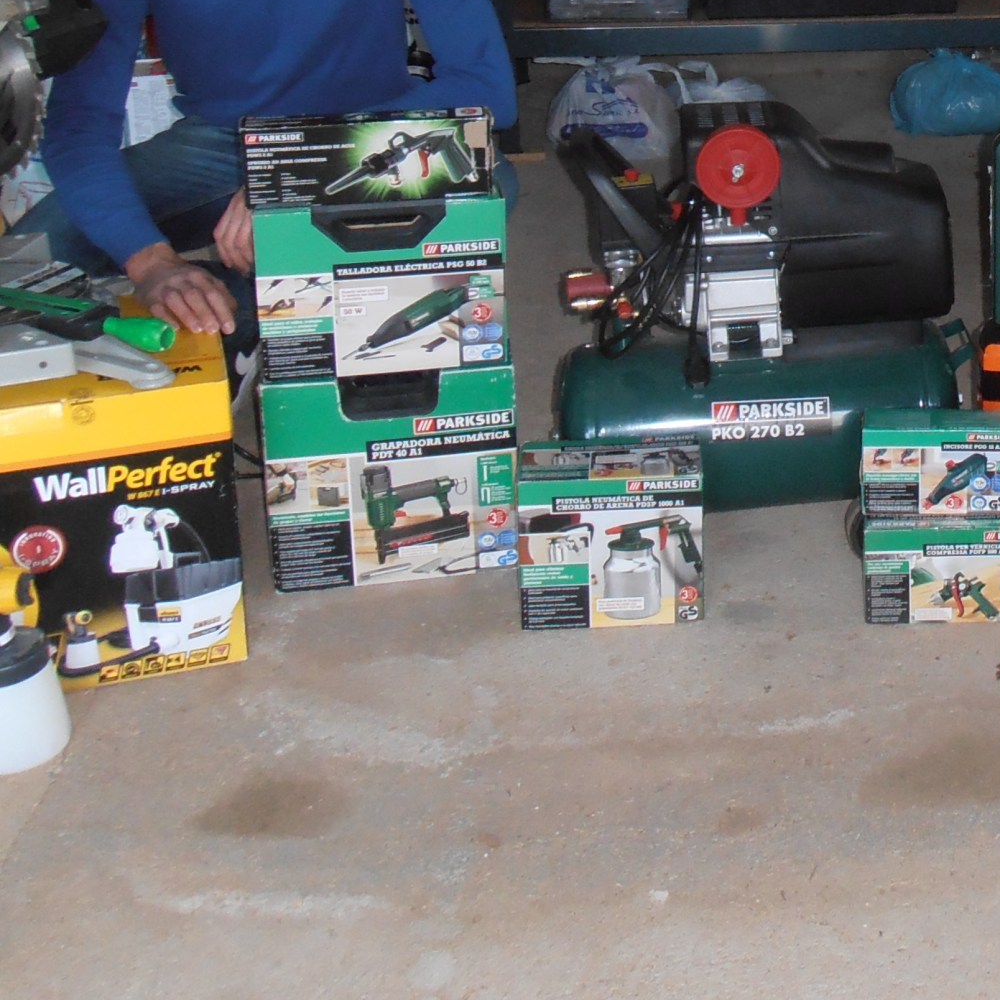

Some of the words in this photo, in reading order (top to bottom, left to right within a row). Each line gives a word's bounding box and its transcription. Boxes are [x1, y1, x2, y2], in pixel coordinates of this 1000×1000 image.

[259, 133, 301, 142] PARKSIDE
[441, 240, 498, 254] PARKSIDE
[337, 264, 392, 276] TALLADORA
[395, 260, 444, 273] ELÉCTRICA
[446, 260, 463, 269] PSG
[466, 260, 475, 268] 50
[738, 401, 825, 418] PARKSIDE
[436, 412, 510, 430] PARKSIDE
[712, 427, 745, 440] PKO
[751, 426, 780, 438] 270
[785, 424, 805, 437] B2
[371, 438, 442, 451] GRAPADORA
[444, 430, 510, 444] NEUMÁTICA
[371, 450, 394, 460] PDT
[396, 449, 408, 458] 40
[409, 448, 423, 457] A1
[33, 452, 222, 502] WallPerfect
[162, 480, 215, 495] I-SPRAY
[642, 480, 697, 490] PARKSIDE
[556, 497, 590, 505] PISTOLA
[592, 494, 640, 503] NEUMÁTICA
[606, 501, 634, 509] ARENA
[948, 499, 954, 508] 3
[488, 512, 496, 524] 3
[497, 550, 518, 565] GS
[681, 589, 688, 598] 3
[679, 607, 698, 620] GS
